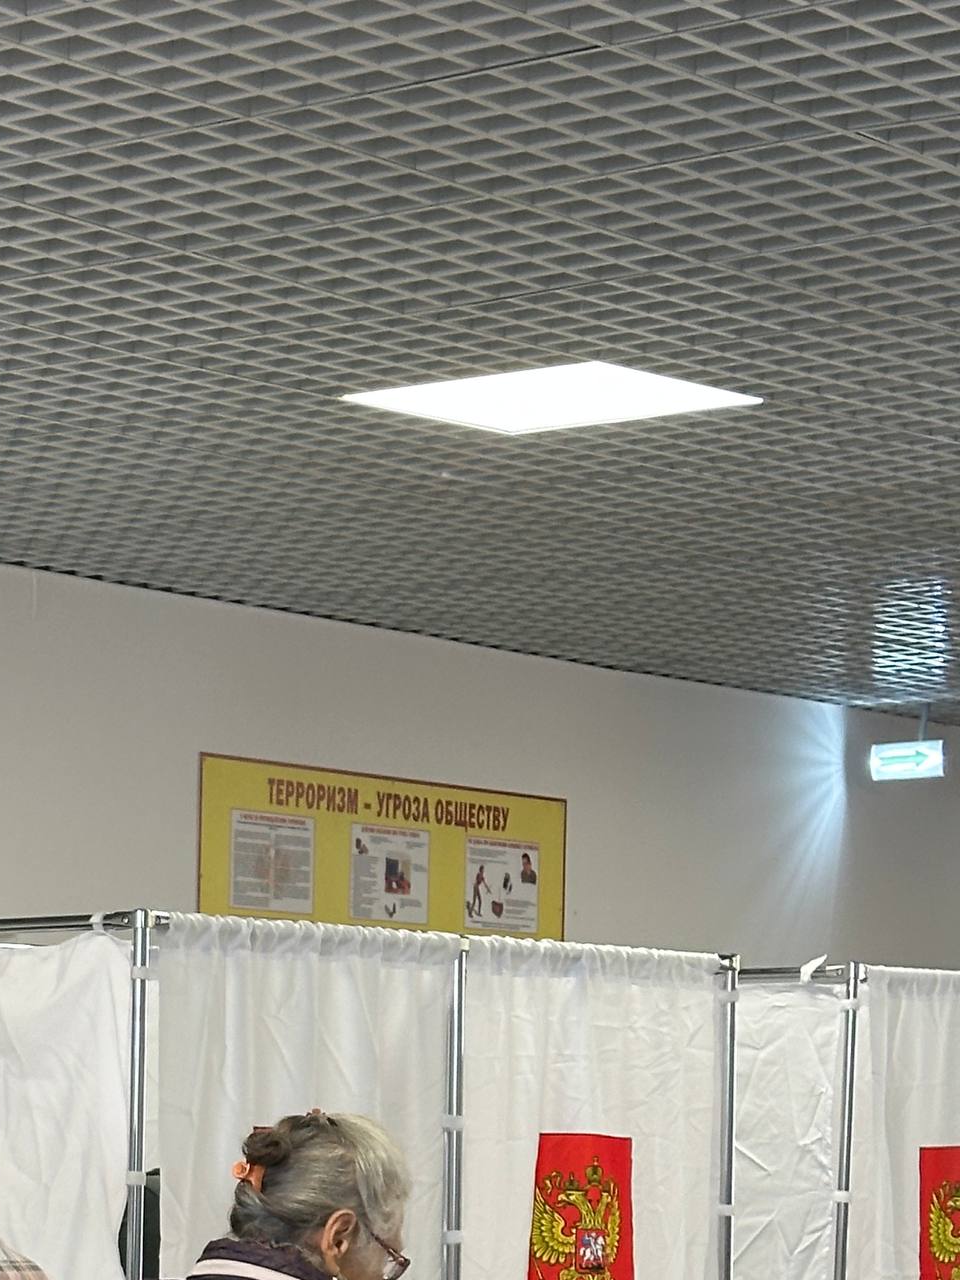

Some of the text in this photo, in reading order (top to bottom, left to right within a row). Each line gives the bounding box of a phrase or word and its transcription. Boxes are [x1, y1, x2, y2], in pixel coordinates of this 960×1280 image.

[267, 777, 359, 816] ТЕРРОРИЗМ
[376, 790, 430, 824] УГРОЗА
[434, 798, 510, 832] ОБЩЕСТВУ
